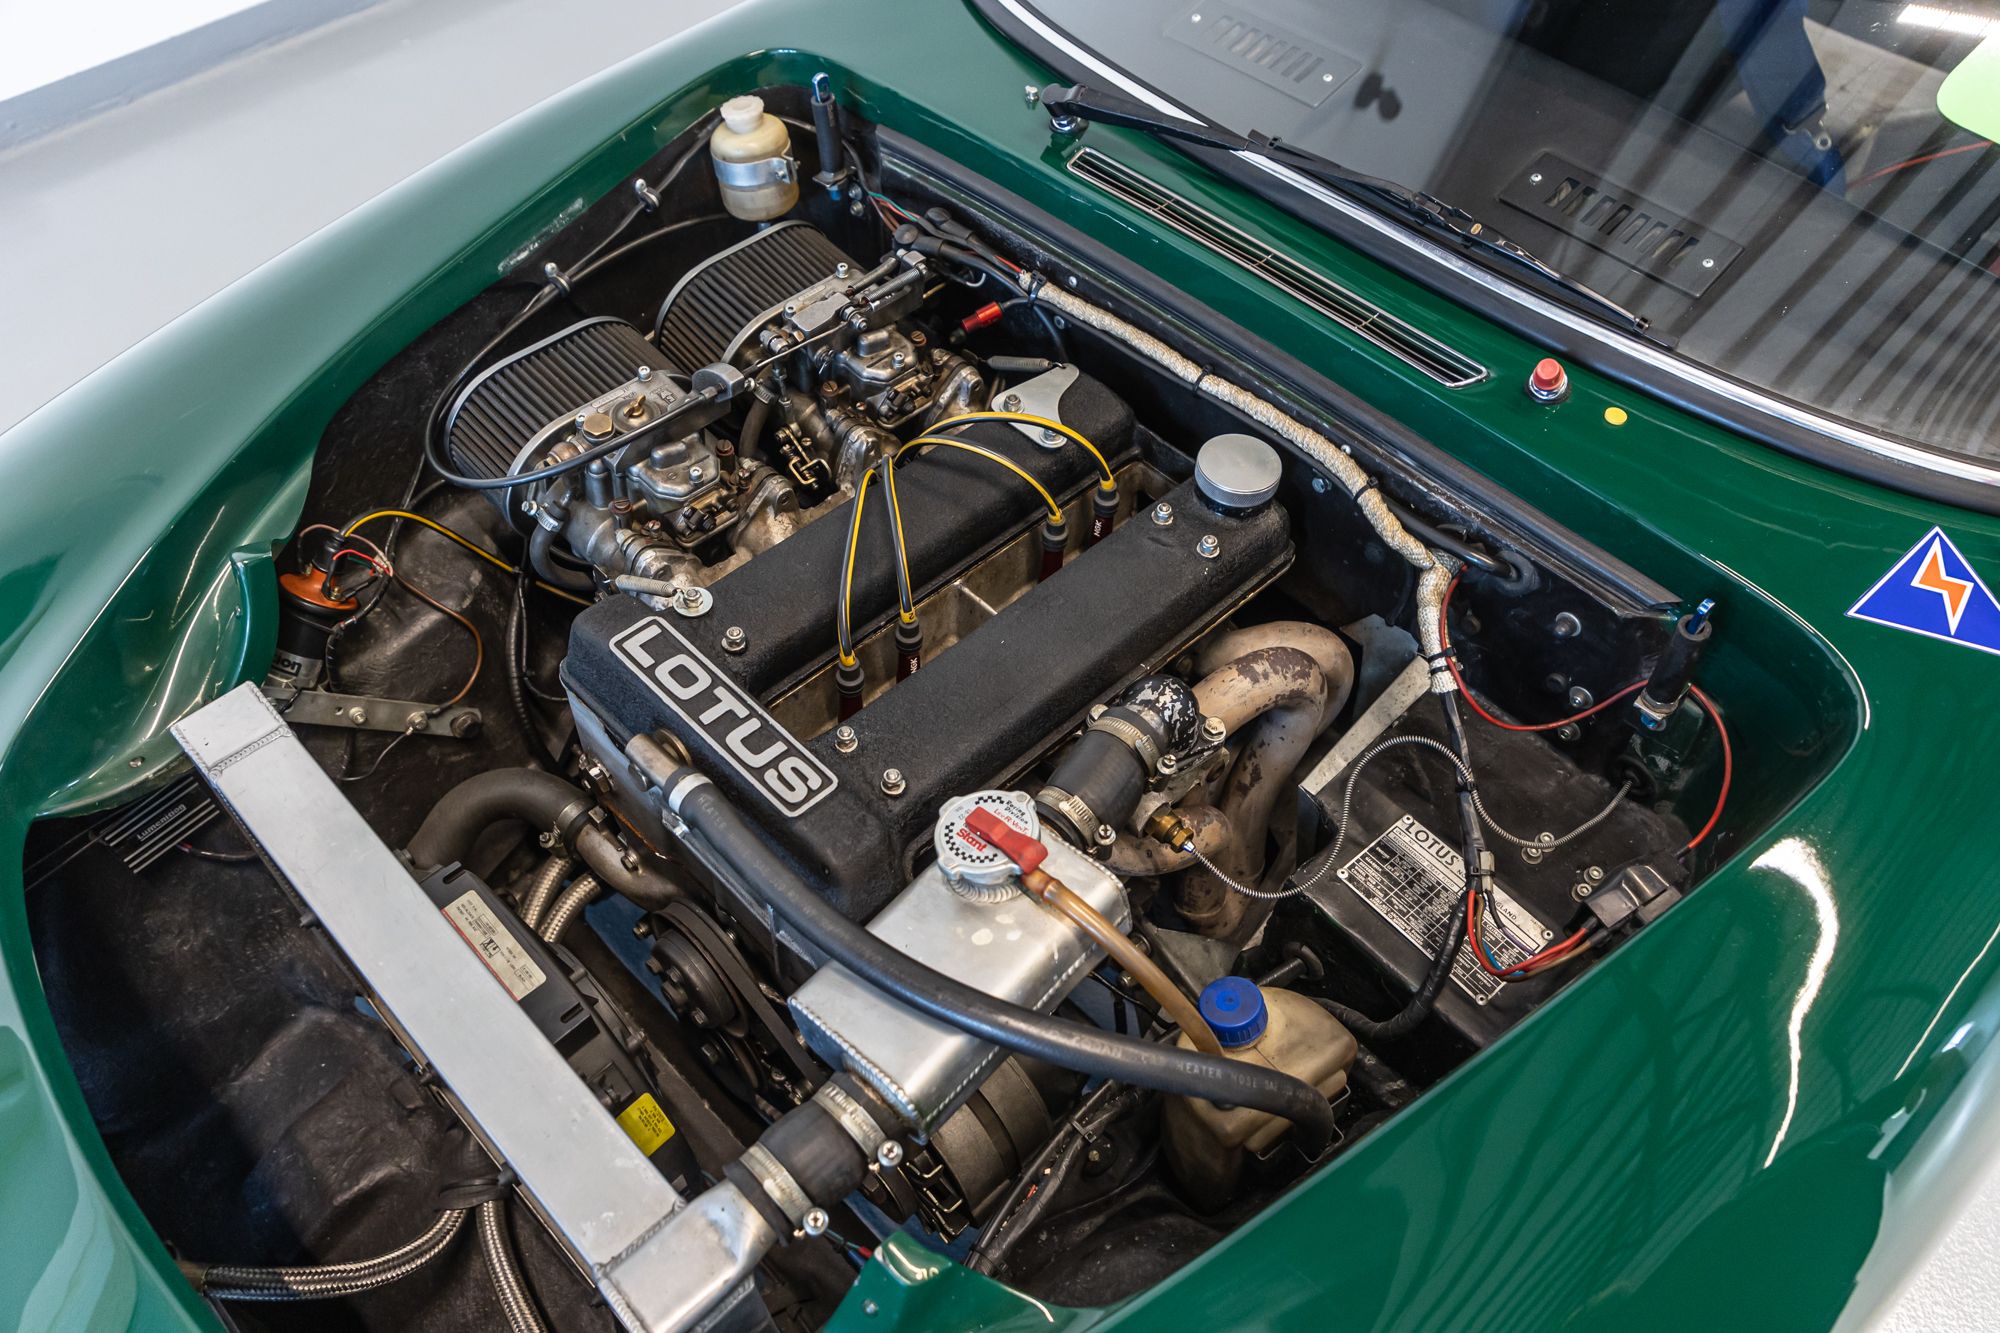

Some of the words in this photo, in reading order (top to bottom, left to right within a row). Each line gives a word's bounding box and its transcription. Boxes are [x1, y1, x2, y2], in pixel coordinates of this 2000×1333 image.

[1093, 519, 1103, 537] NGK
[622, 624, 822, 803] LOTUS
[1004, 807, 1028, 825] Division
[1005, 801, 1026, 816] Racing
[136, 803, 187, 842] Lumenition
[956, 828, 988, 853] Stant
[1392, 835, 1426, 864] RECOMMENDED
[1404, 821, 1459, 867] LOTUS
[1493, 900, 1517, 920] GLAND
[1176, 1062, 1222, 1079] HEATER
[1231, 1072, 1257, 1088] HOSE
